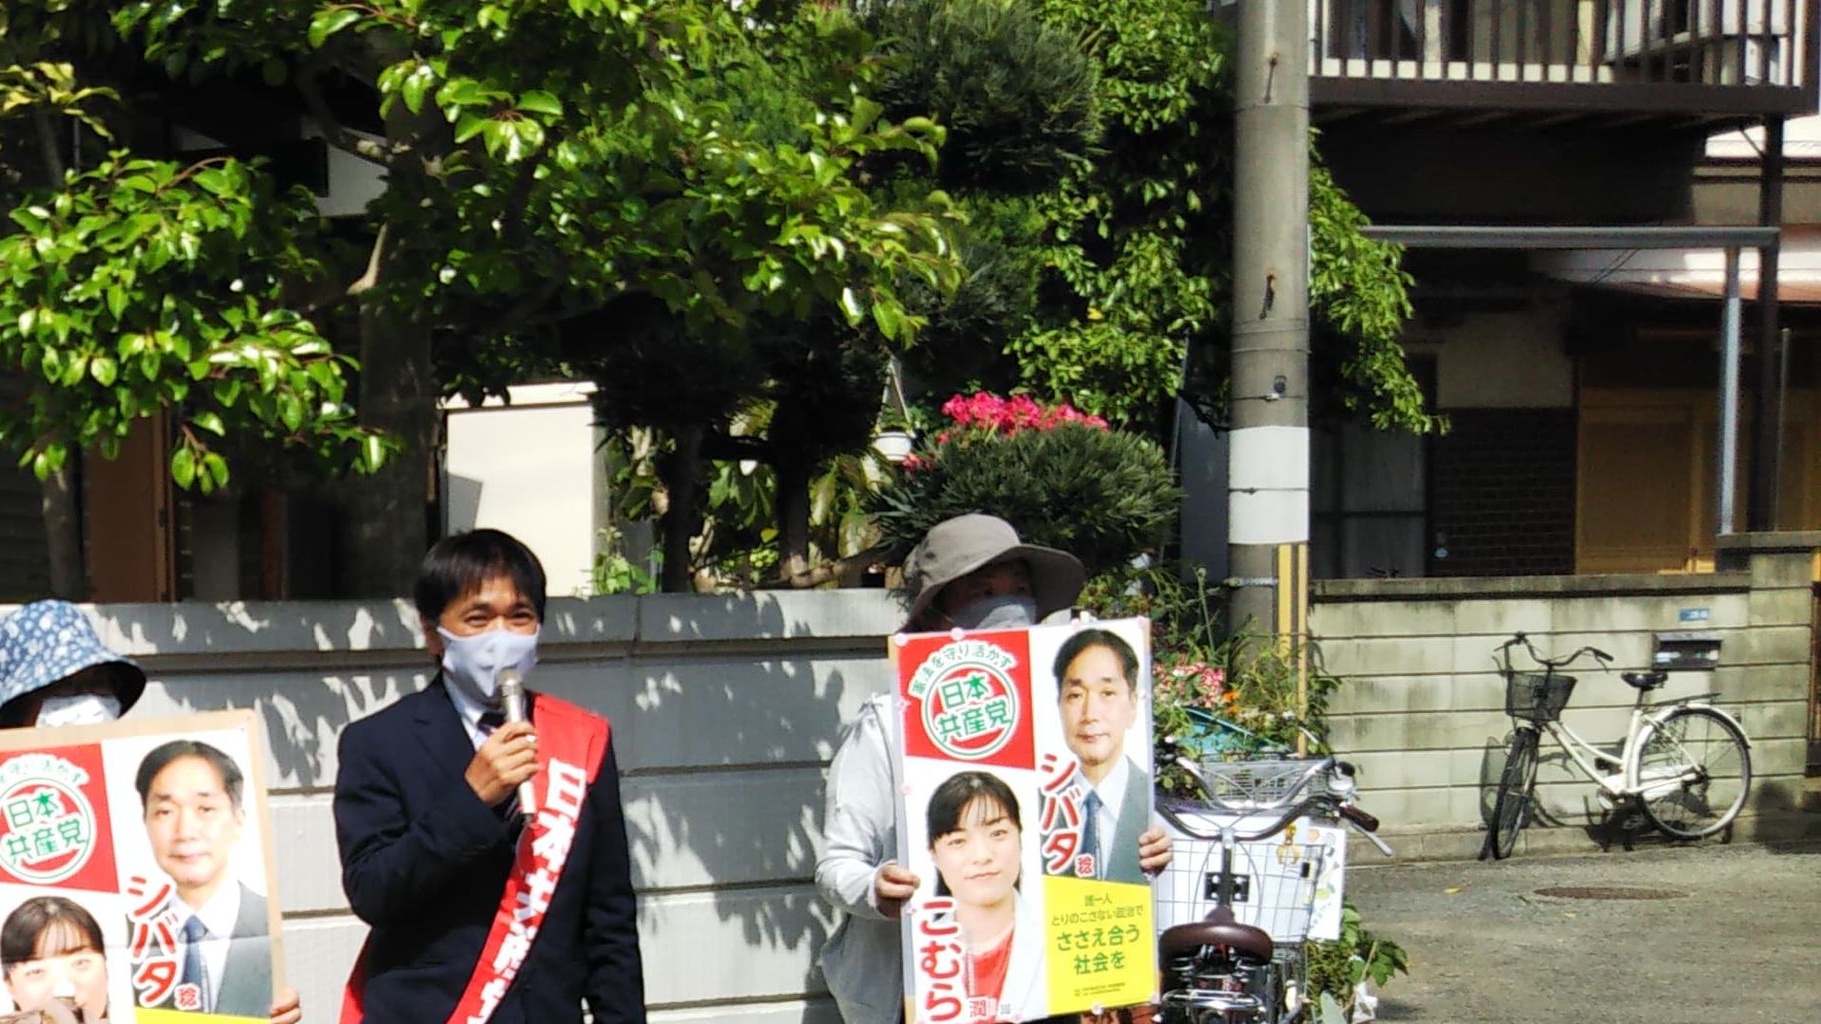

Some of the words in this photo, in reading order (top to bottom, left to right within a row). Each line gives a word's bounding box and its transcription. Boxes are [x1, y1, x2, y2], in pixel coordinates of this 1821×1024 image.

[941, 675, 989, 710] 日本
[937, 699, 1013, 743] 共産党
[1041, 752, 1082, 872] シバタ
[127, 875, 179, 1003] シバタ
[1056, 923, 1141, 952] ささえ合う
[919, 900, 963, 1022] こむら
[1073, 950, 1126, 976] 社会を
